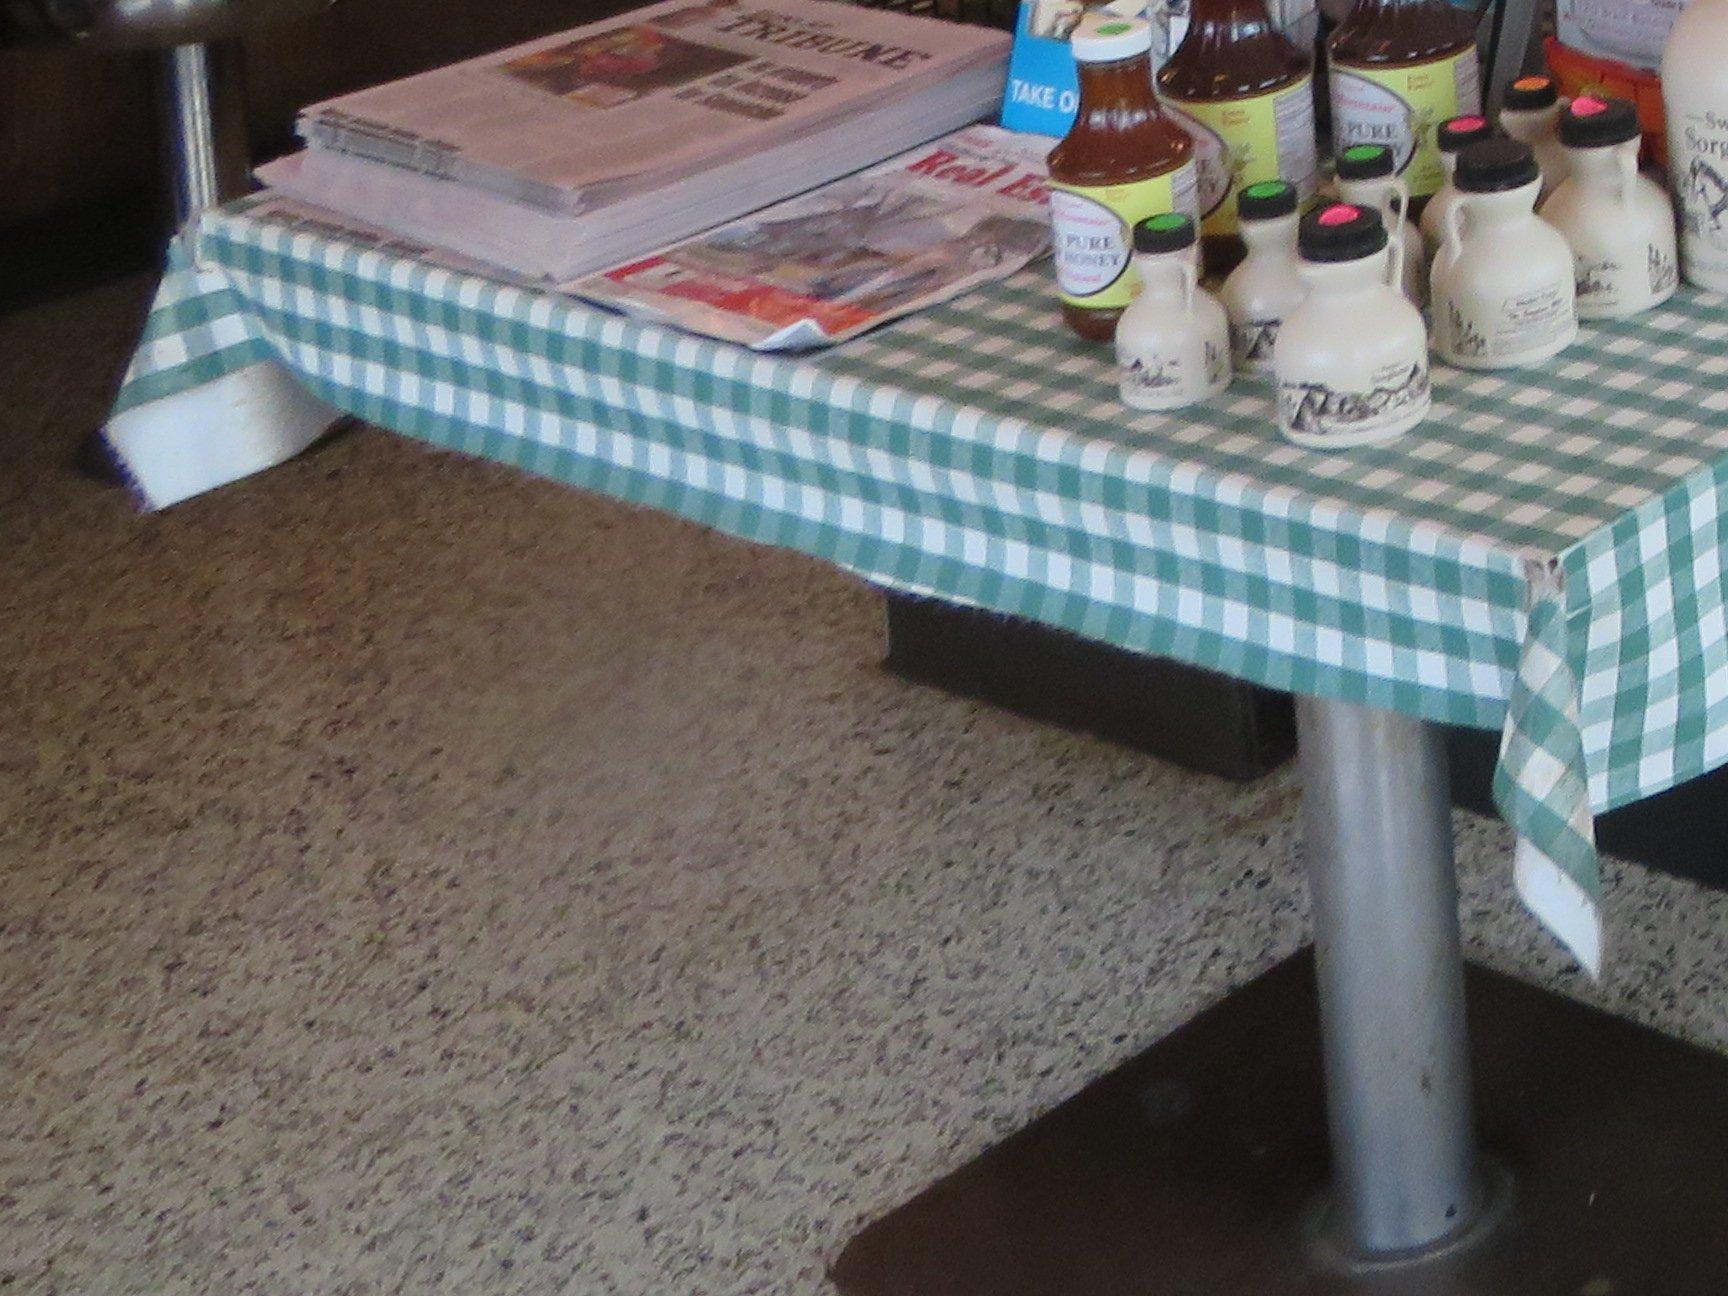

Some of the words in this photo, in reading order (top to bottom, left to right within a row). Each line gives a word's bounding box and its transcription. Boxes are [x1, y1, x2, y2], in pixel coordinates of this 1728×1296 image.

[716, 13, 932, 70] TRIBUNE
[1011, 79, 1055, 108] TAKE
[906, 149, 1020, 187] Real
[1066, 233, 1113, 251] PURE
